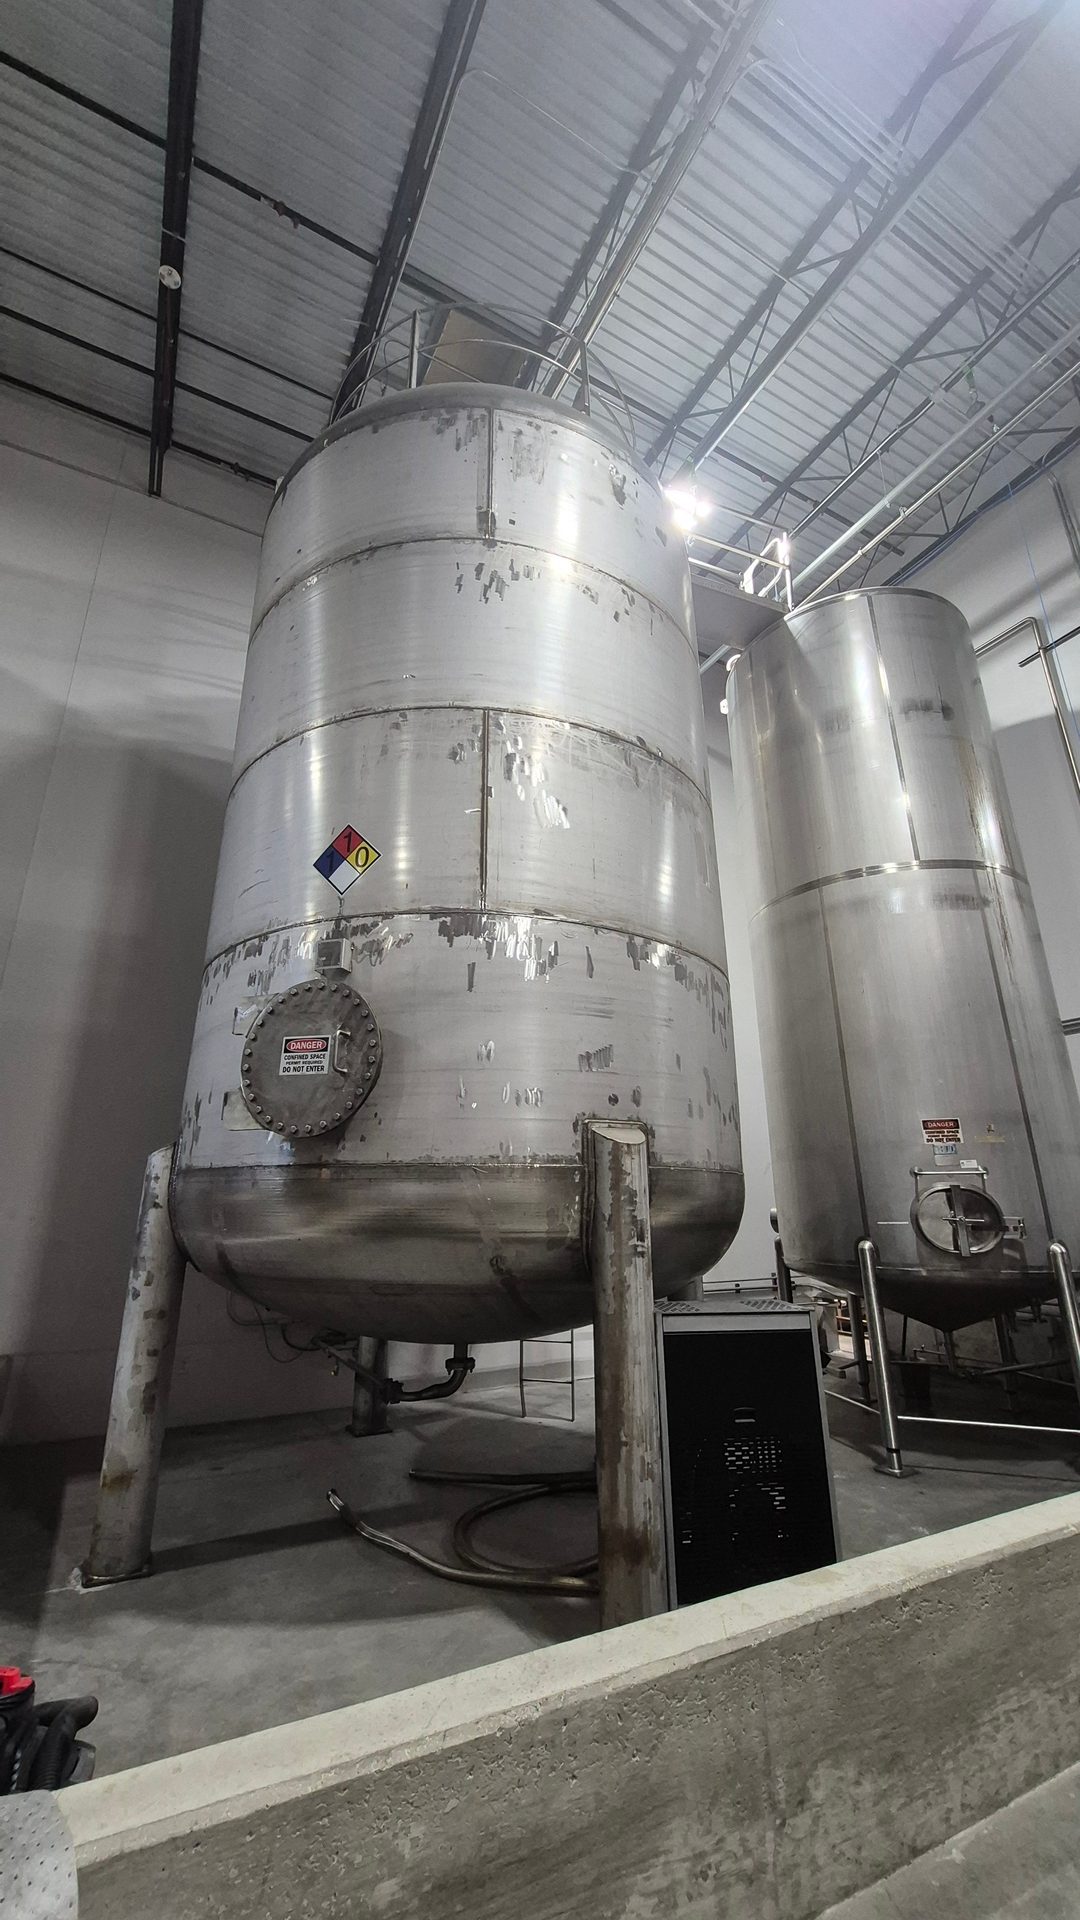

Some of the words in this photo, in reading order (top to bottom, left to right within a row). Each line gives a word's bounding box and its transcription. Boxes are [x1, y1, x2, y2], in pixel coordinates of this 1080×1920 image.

[343, 831, 352, 853] 1
[355, 846, 370, 868] 0
[290, 1041, 323, 1050] DANGER
